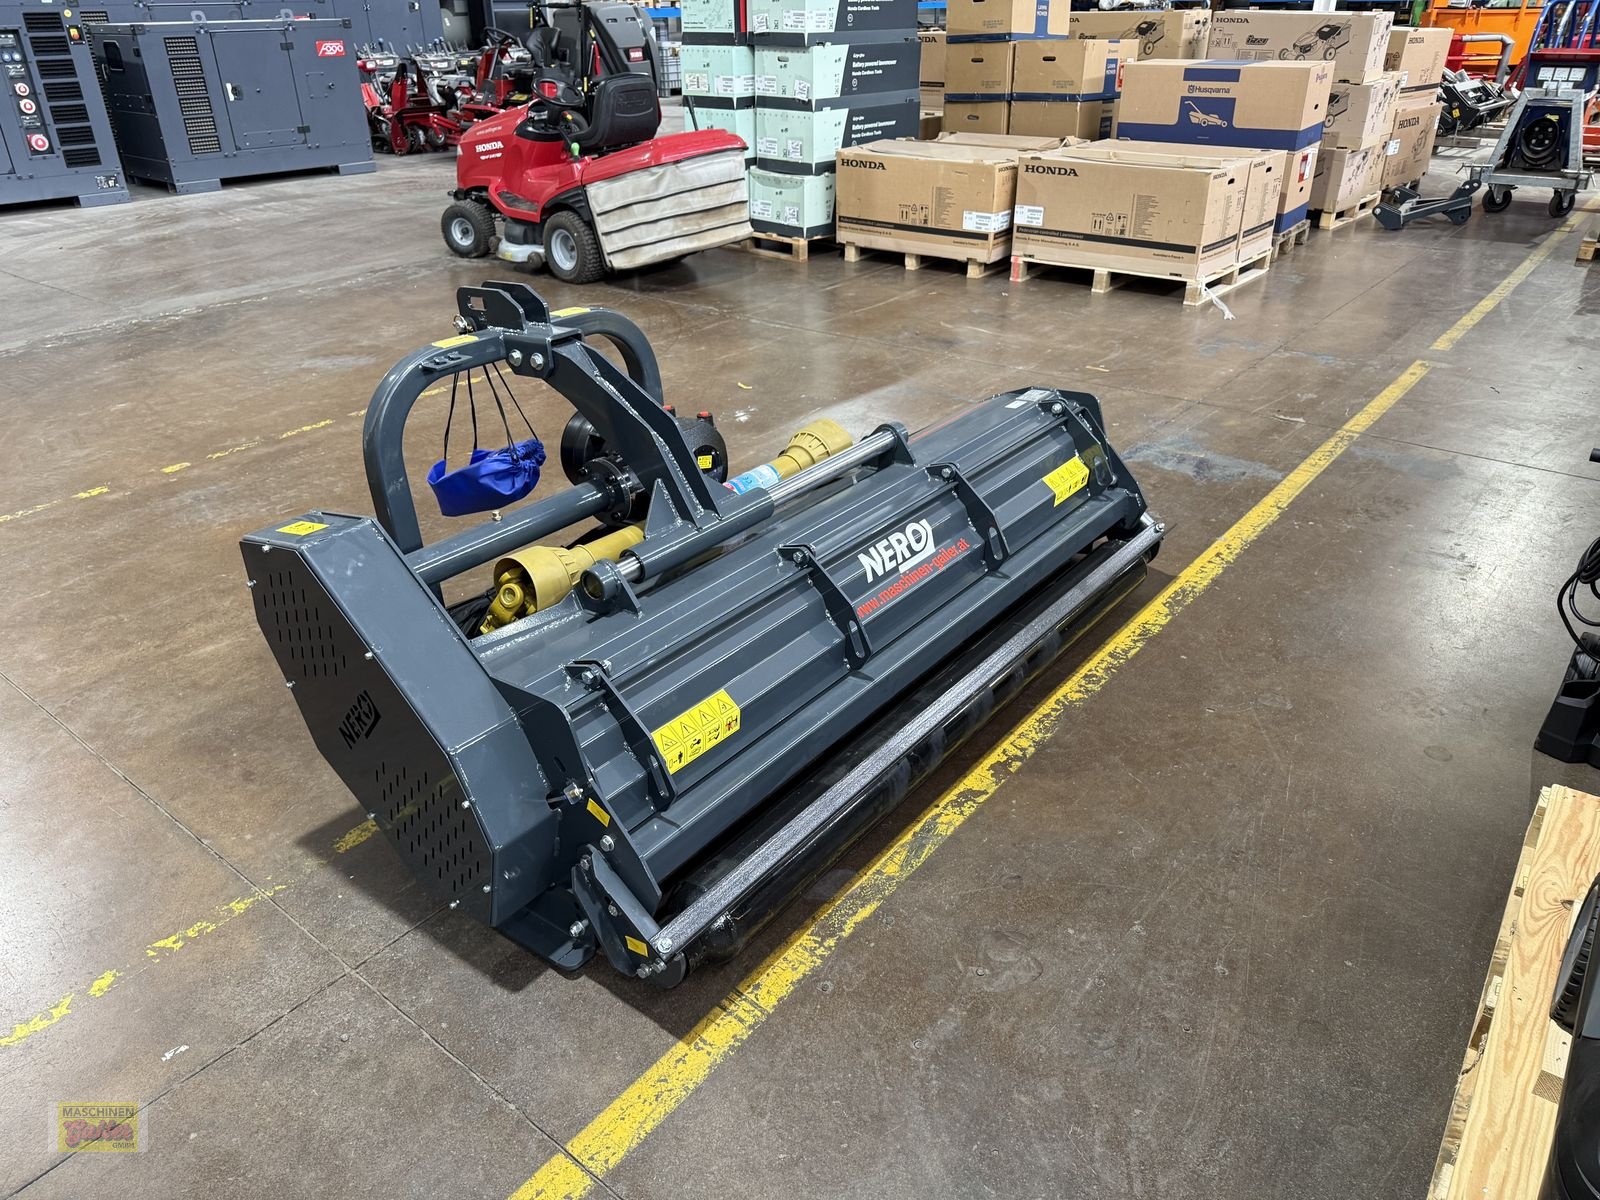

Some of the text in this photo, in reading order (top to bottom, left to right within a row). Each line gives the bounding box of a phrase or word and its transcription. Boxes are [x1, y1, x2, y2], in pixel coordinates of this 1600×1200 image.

[1408, 37, 1425, 45] HONDA
[1194, 85, 1231, 95] Husqvarna
[1398, 116, 1420, 130] HONDA
[475, 140, 504, 153] HONDA
[841, 158, 887, 171] HONDA
[1023, 164, 1079, 177] HONDA
[857, 519, 935, 583] NERO
[857, 537, 971, 619] www.maschinen-gailer.at
[339, 691, 378, 751] NERO
